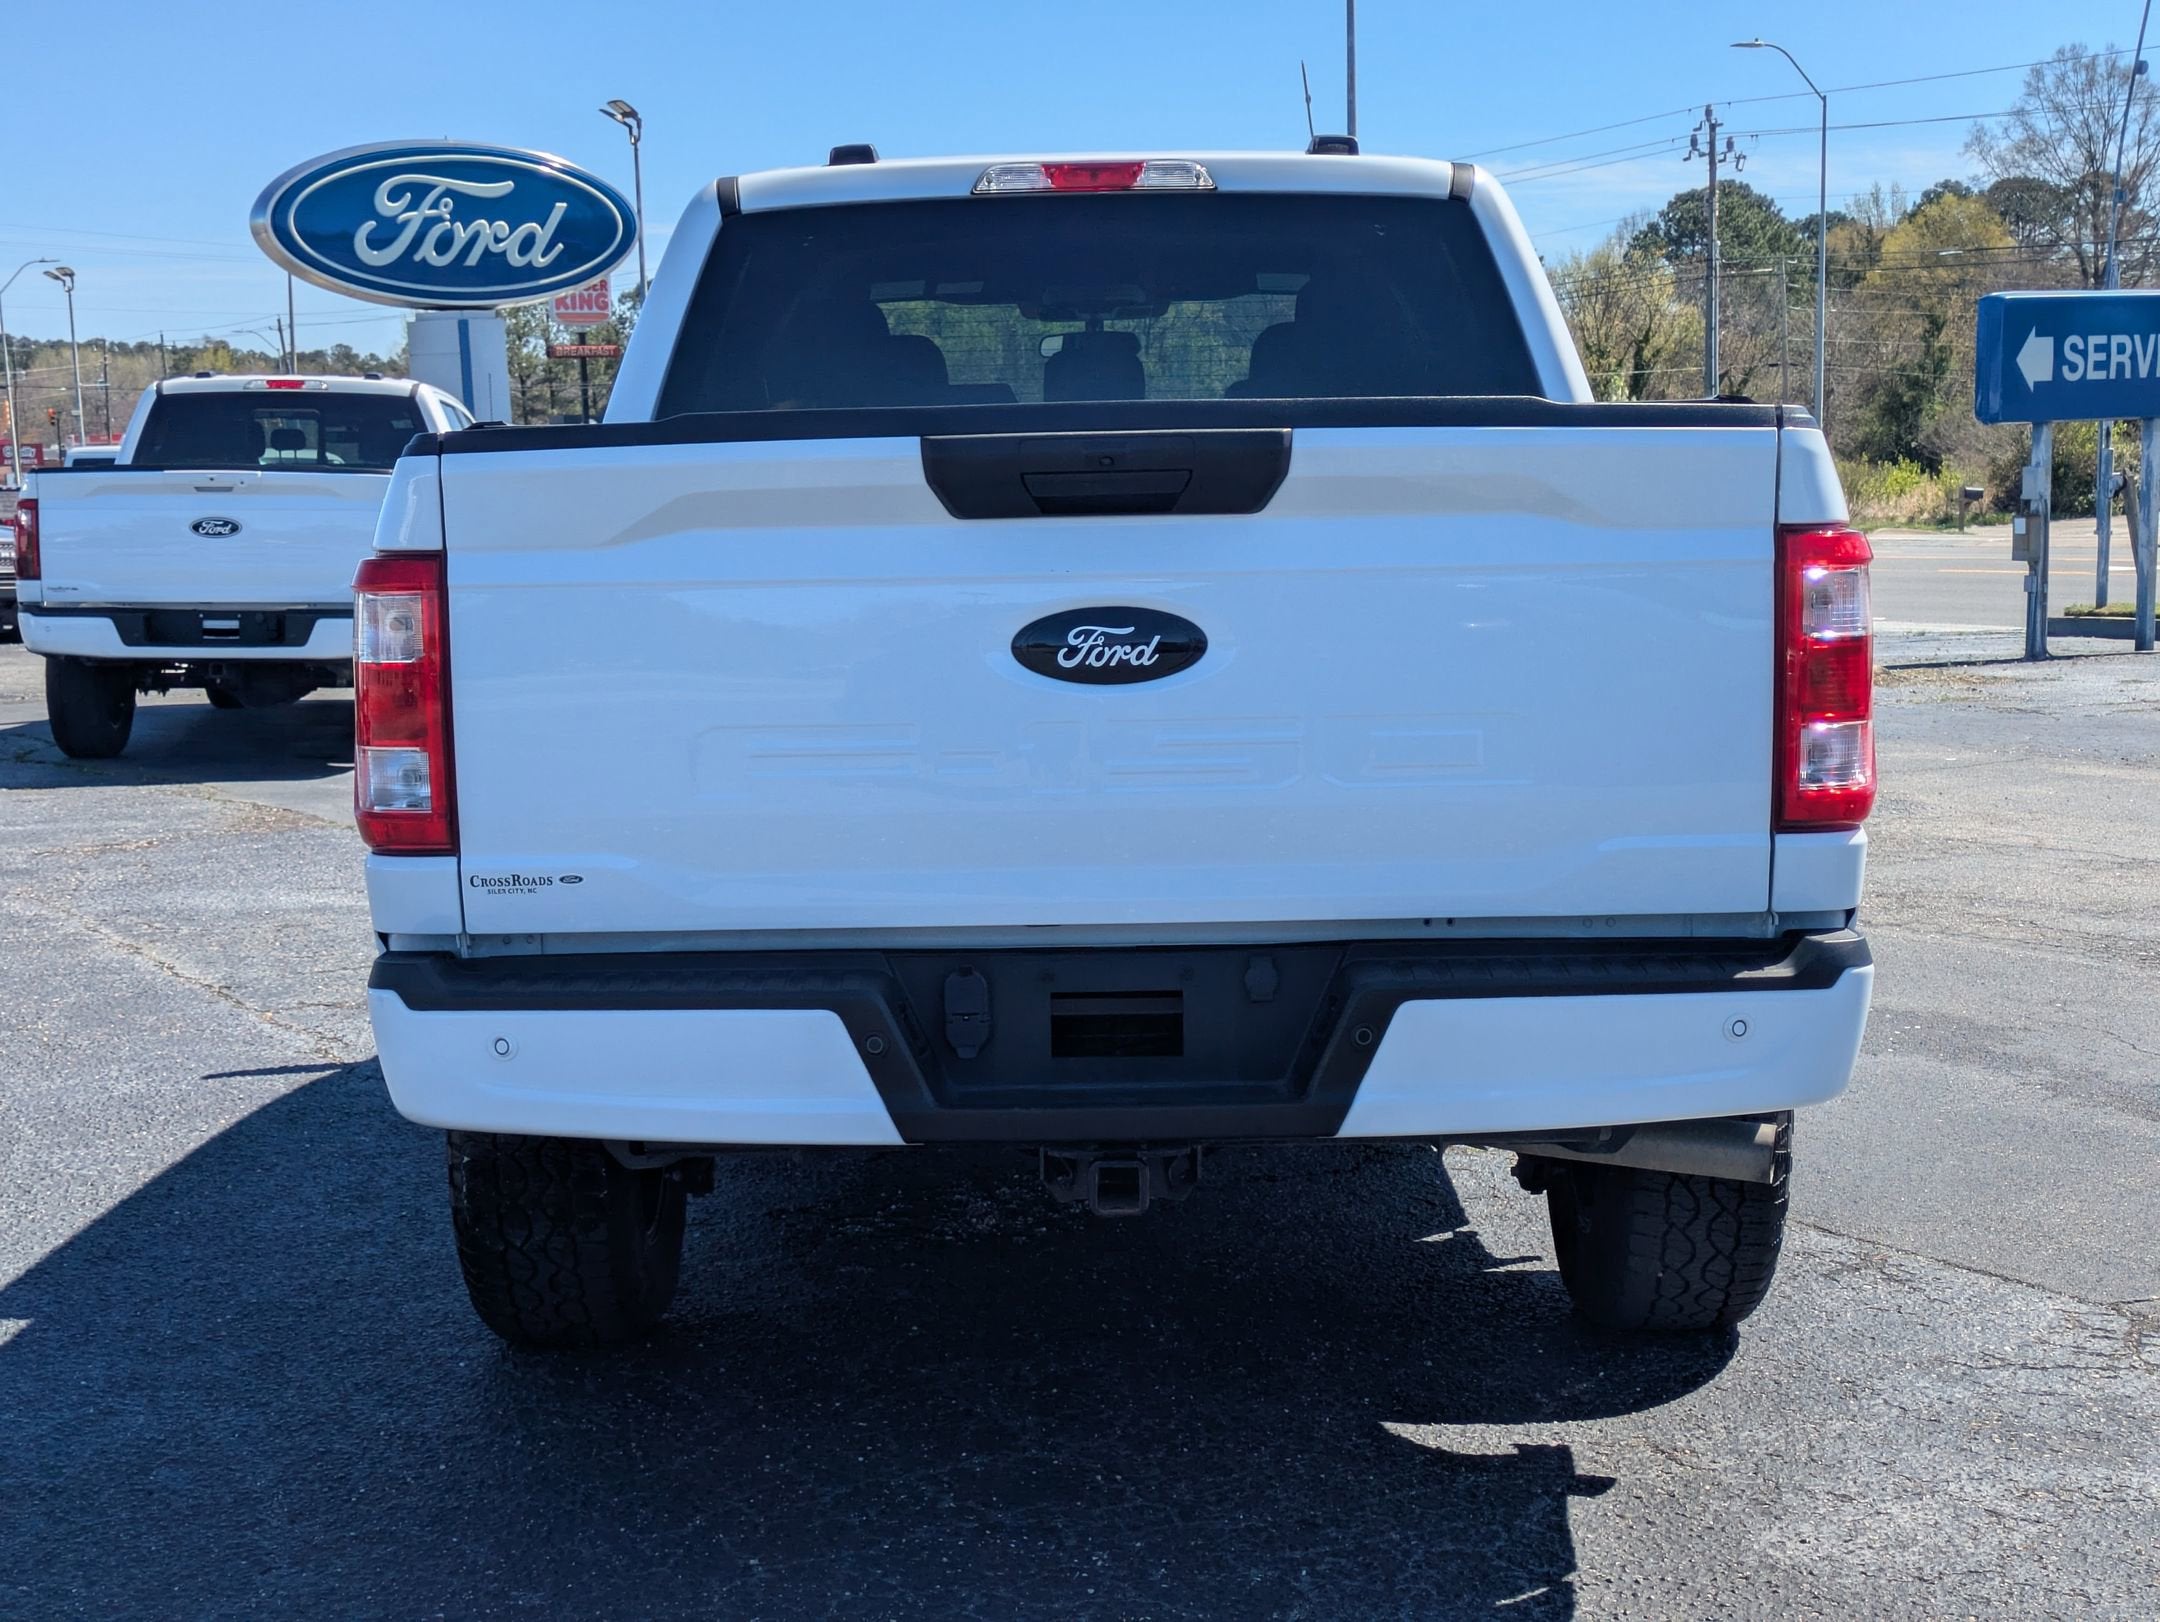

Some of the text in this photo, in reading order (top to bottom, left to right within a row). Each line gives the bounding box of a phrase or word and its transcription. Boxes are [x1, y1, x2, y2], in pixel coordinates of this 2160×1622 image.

[354, 174, 568, 267] Ford
[555, 292, 609, 311] KING
[555, 345, 615, 357] BREAKFAST
[199, 521, 232, 534] Ford
[1057, 625, 1161, 668] Ford
